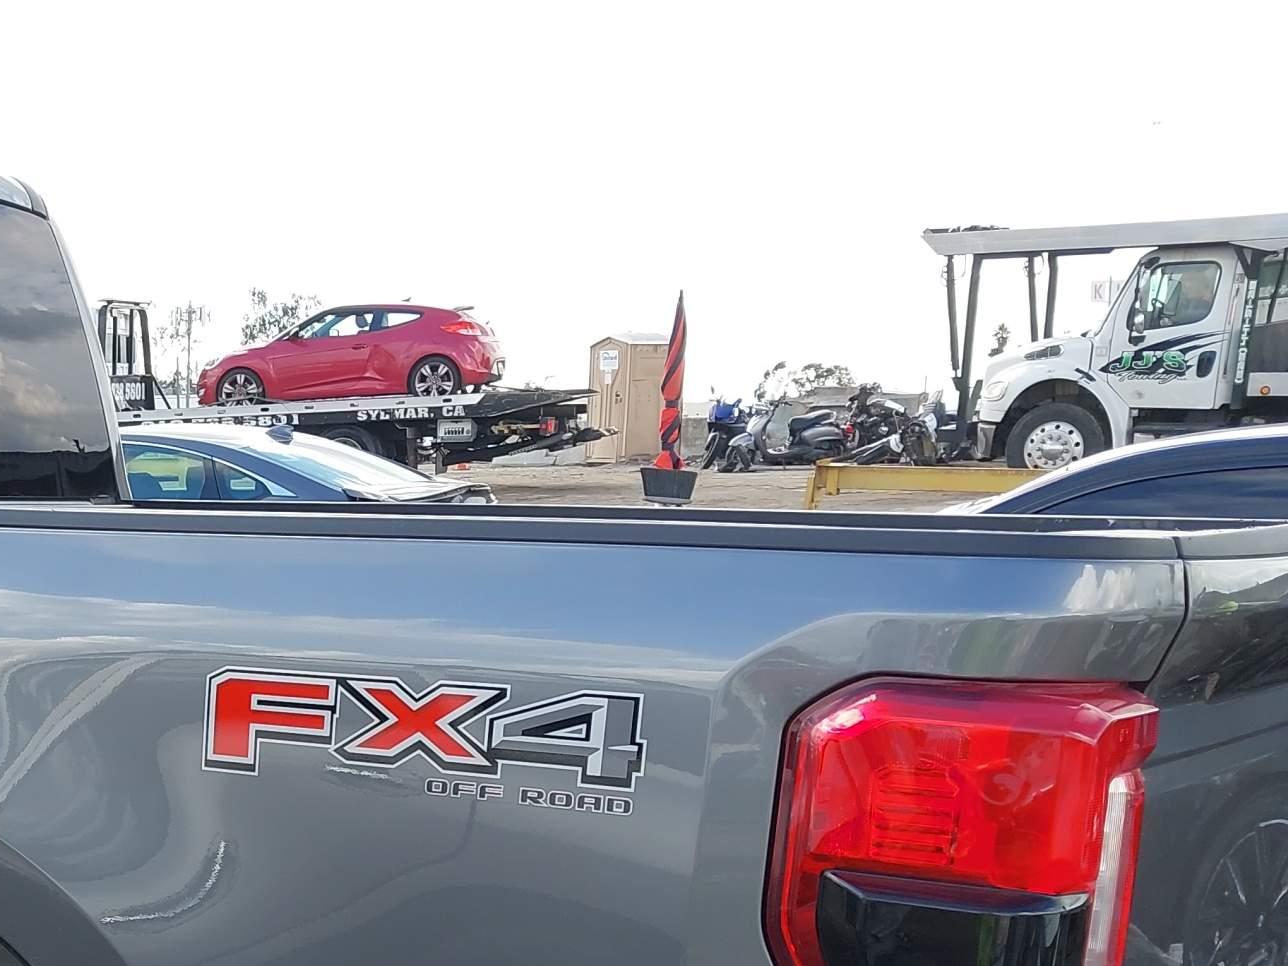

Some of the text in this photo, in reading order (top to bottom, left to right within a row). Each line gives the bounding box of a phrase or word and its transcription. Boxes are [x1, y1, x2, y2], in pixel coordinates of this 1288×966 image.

[441, 405, 465, 417] CA
[201, 665, 647, 791] FX4
[423, 777, 633, 818] OFF ROAD
